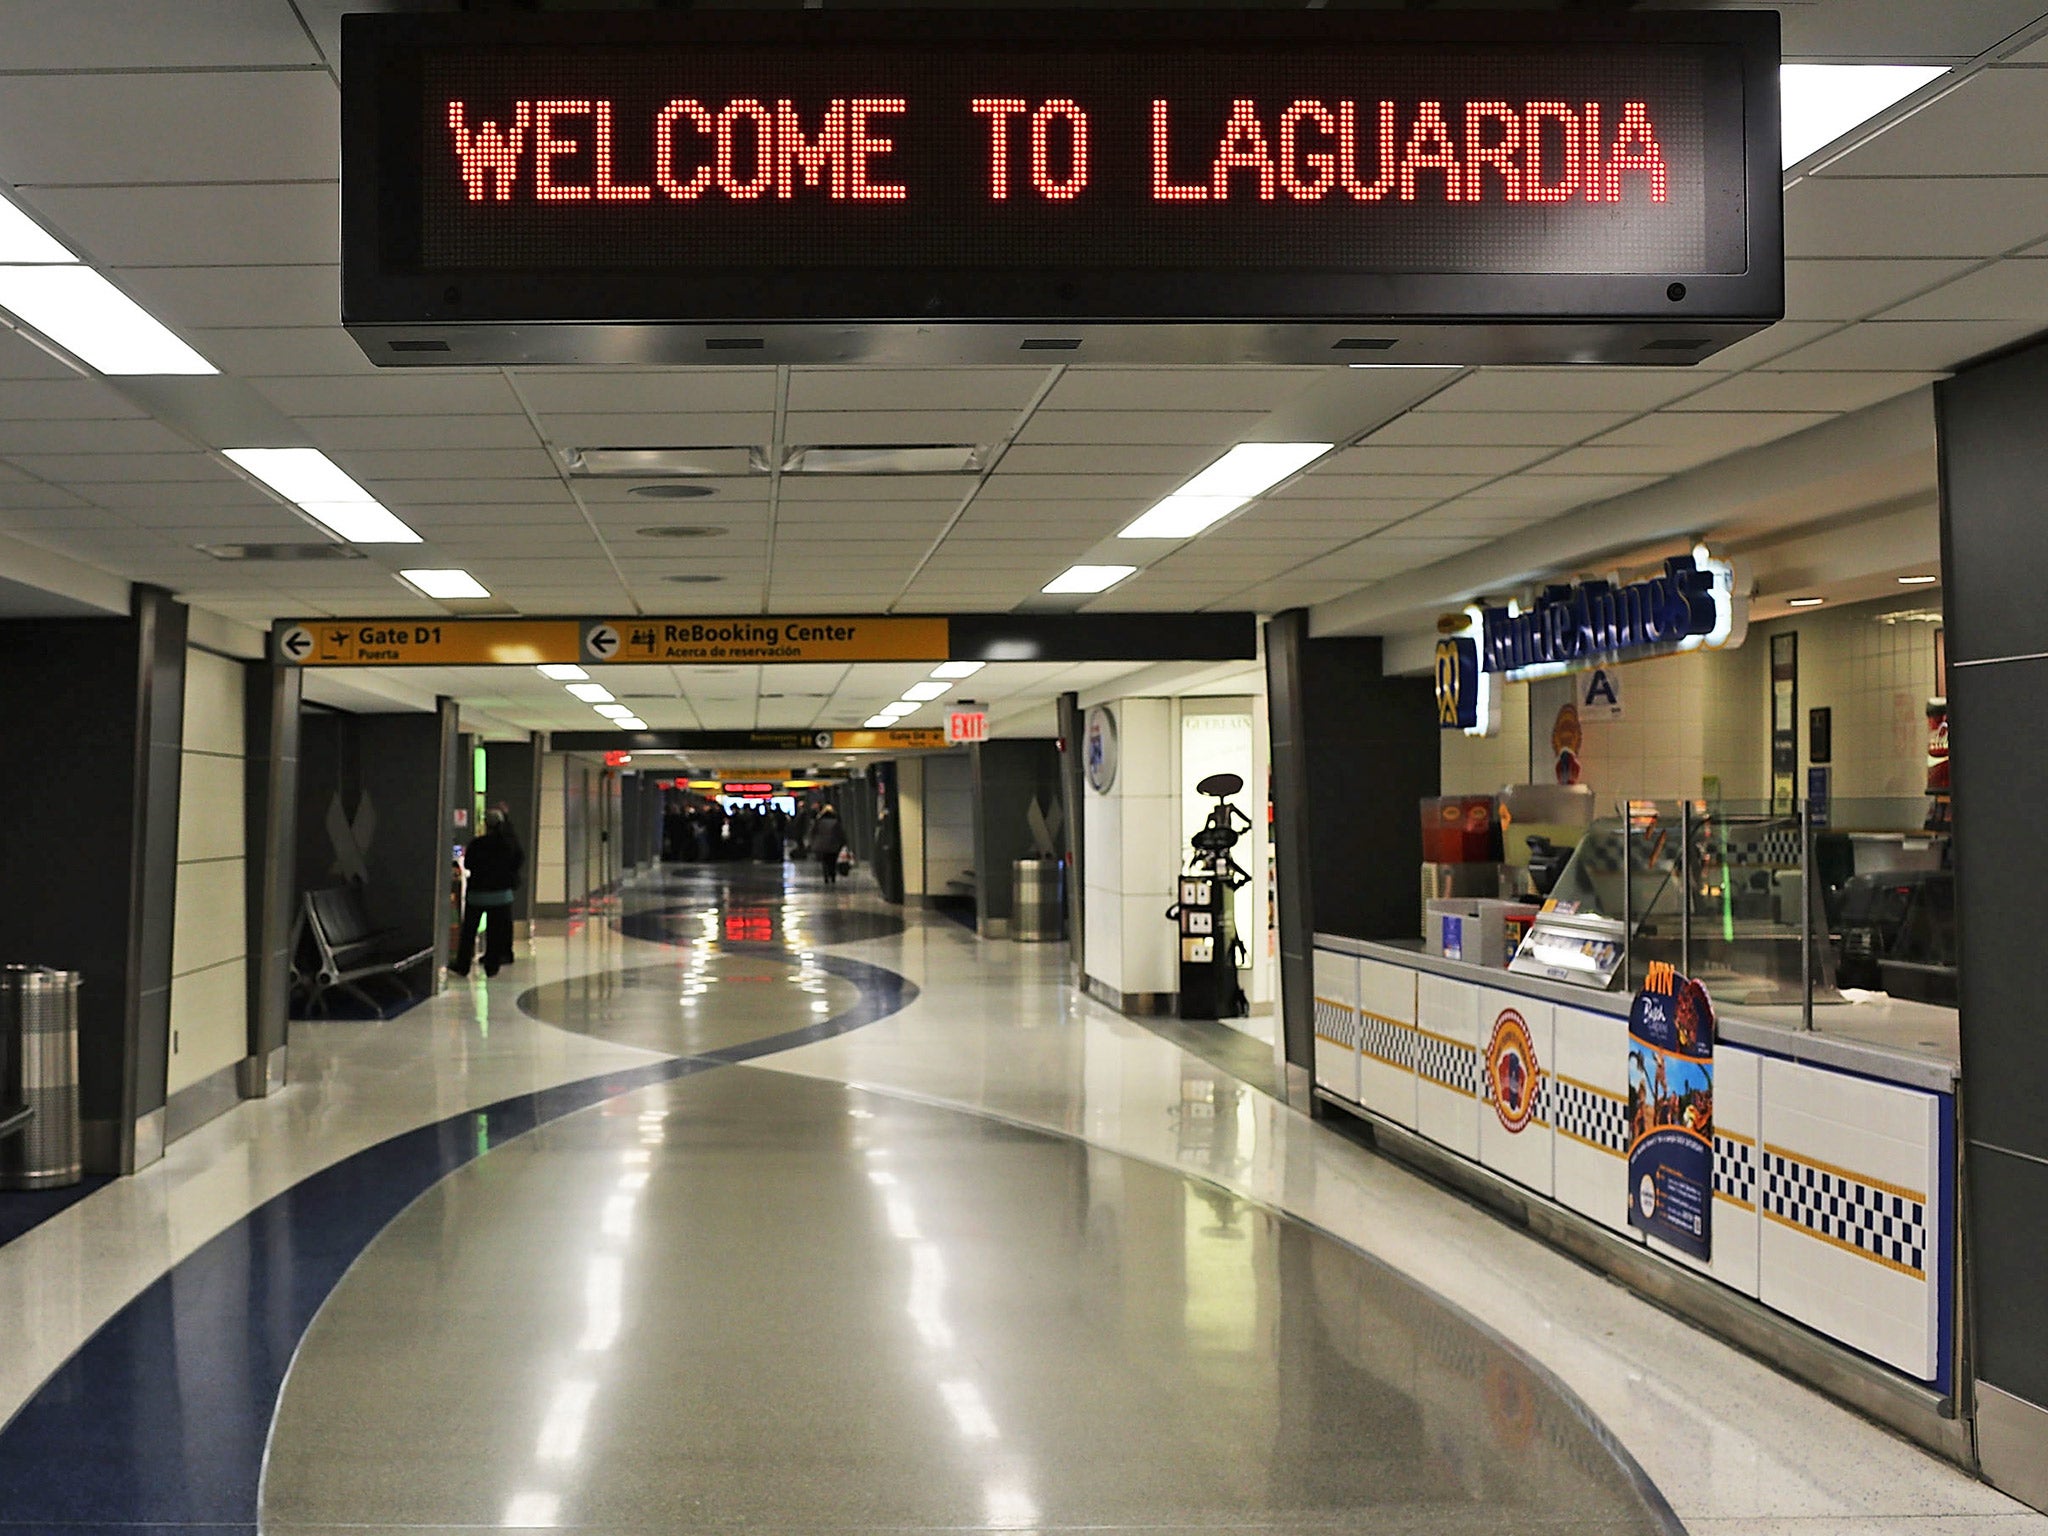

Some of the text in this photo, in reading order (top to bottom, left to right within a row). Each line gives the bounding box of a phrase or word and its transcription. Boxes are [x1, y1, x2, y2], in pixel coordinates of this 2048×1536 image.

[448, 97, 1669, 203] WELCOME TO LAGUARDIA
[358, 626, 442, 644] Gate D1
[665, 622, 856, 645] ReBooking Center
[358, 648, 399, 660] Puerta
[665, 644, 801, 658] Acerca de reservación
[1586, 669, 1617, 706] A
[950, 712, 984, 740] EXIT
